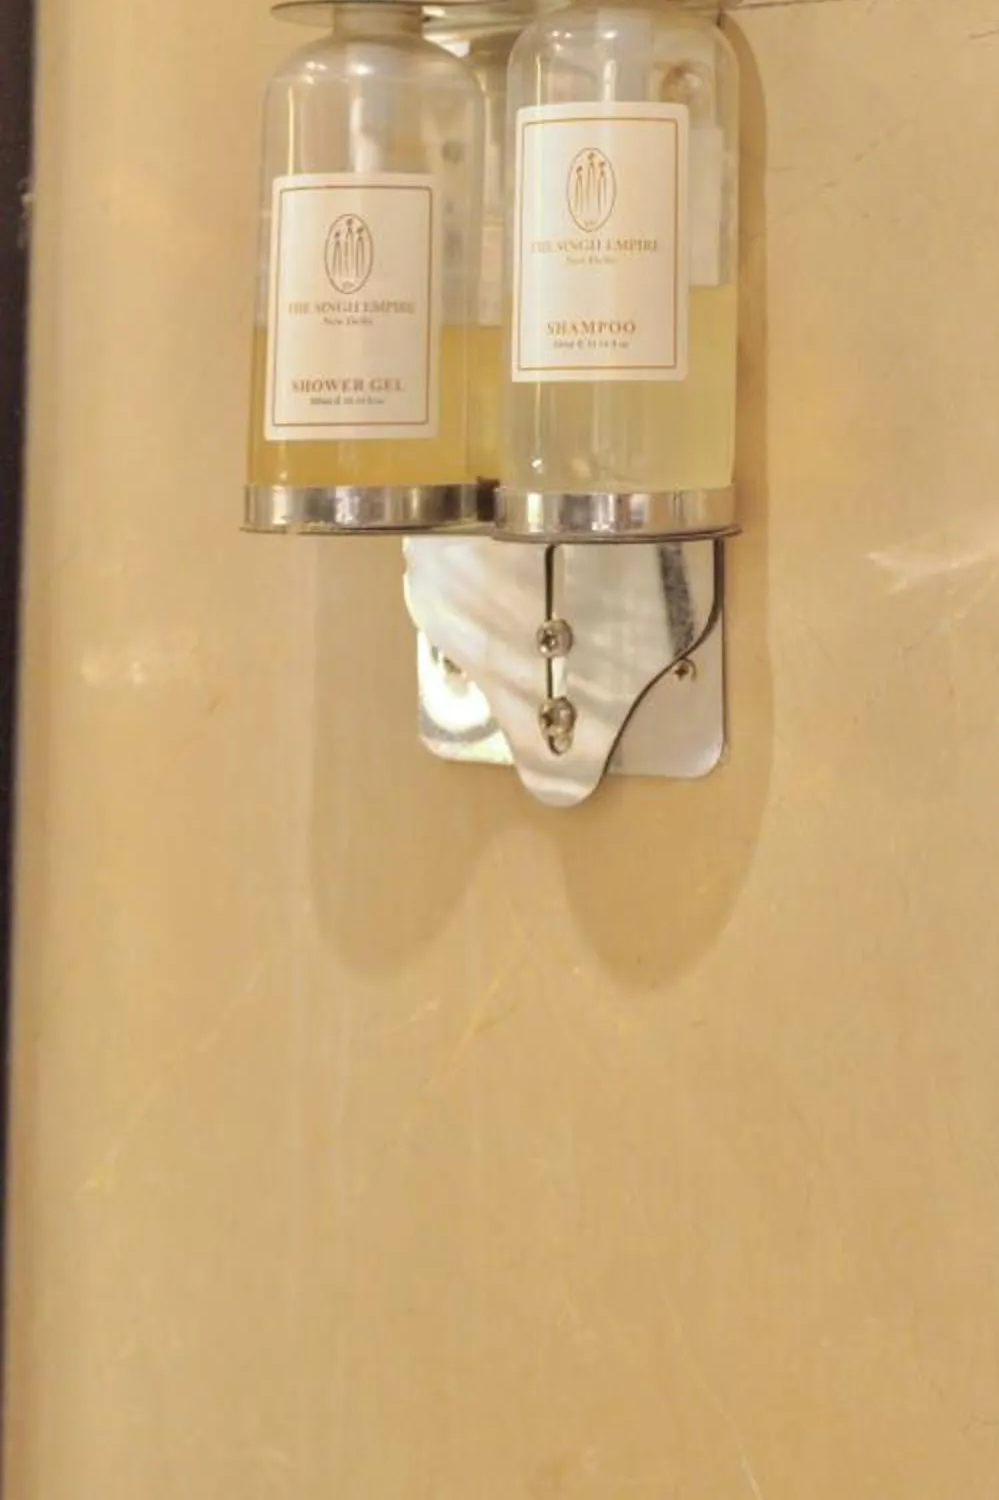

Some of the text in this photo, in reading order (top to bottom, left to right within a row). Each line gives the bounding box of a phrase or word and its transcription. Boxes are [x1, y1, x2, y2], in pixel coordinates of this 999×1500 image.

[546, 320, 637, 336] SHAMPOO
[291, 378, 406, 393] SHOWER GEL
